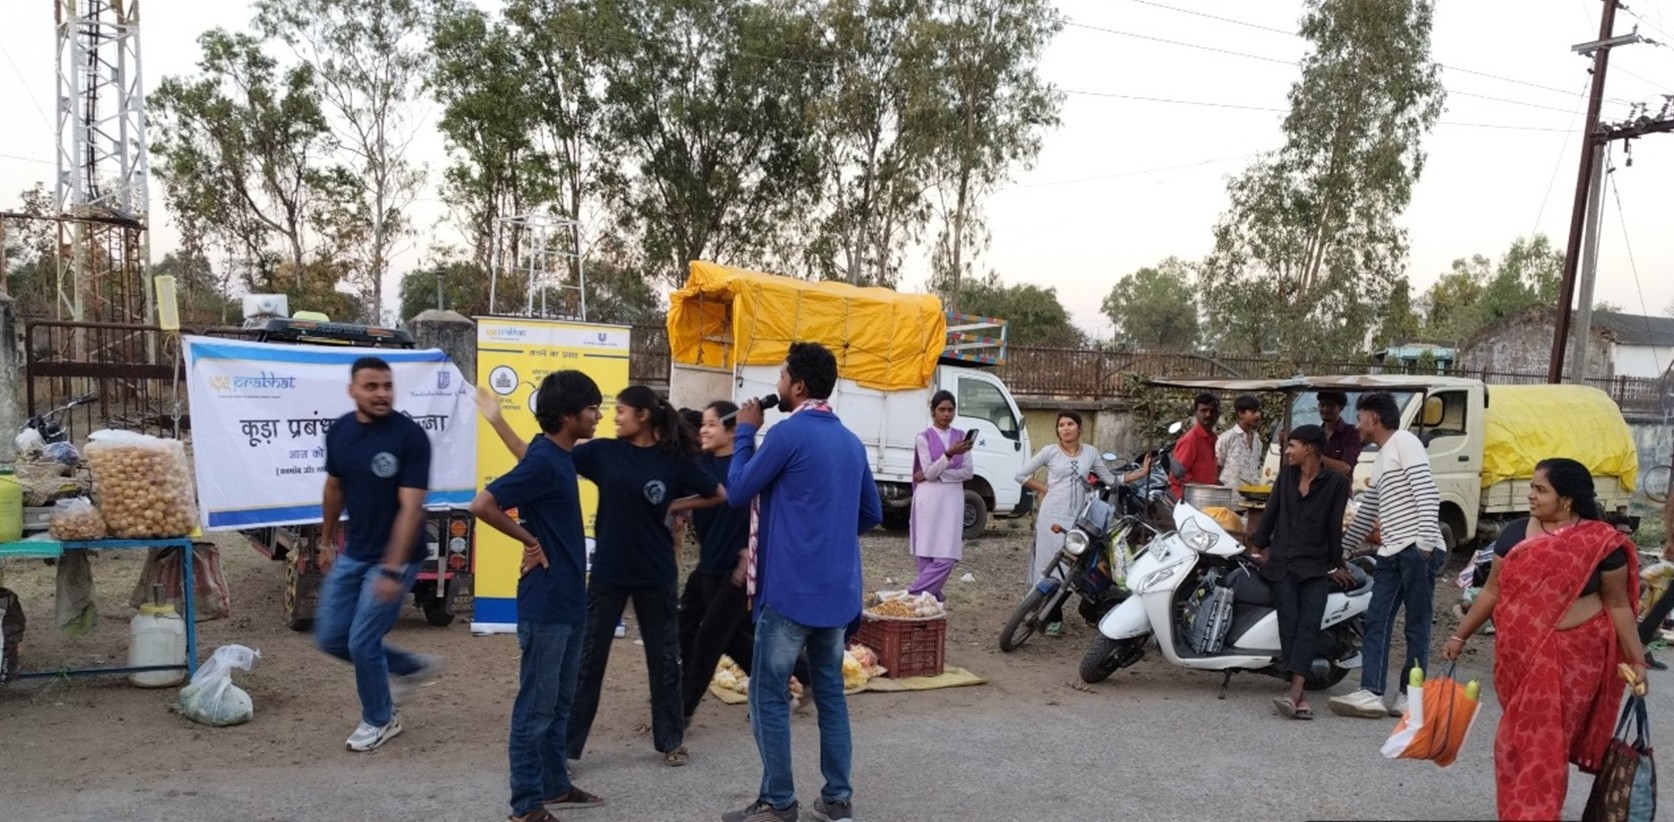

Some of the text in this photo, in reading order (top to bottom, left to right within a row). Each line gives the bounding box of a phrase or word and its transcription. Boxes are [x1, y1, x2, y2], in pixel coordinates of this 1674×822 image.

[233, 371, 296, 392] prabhat
[239, 419, 280, 447] कूड़ा
[287, 410, 339, 439] प्रबंध
